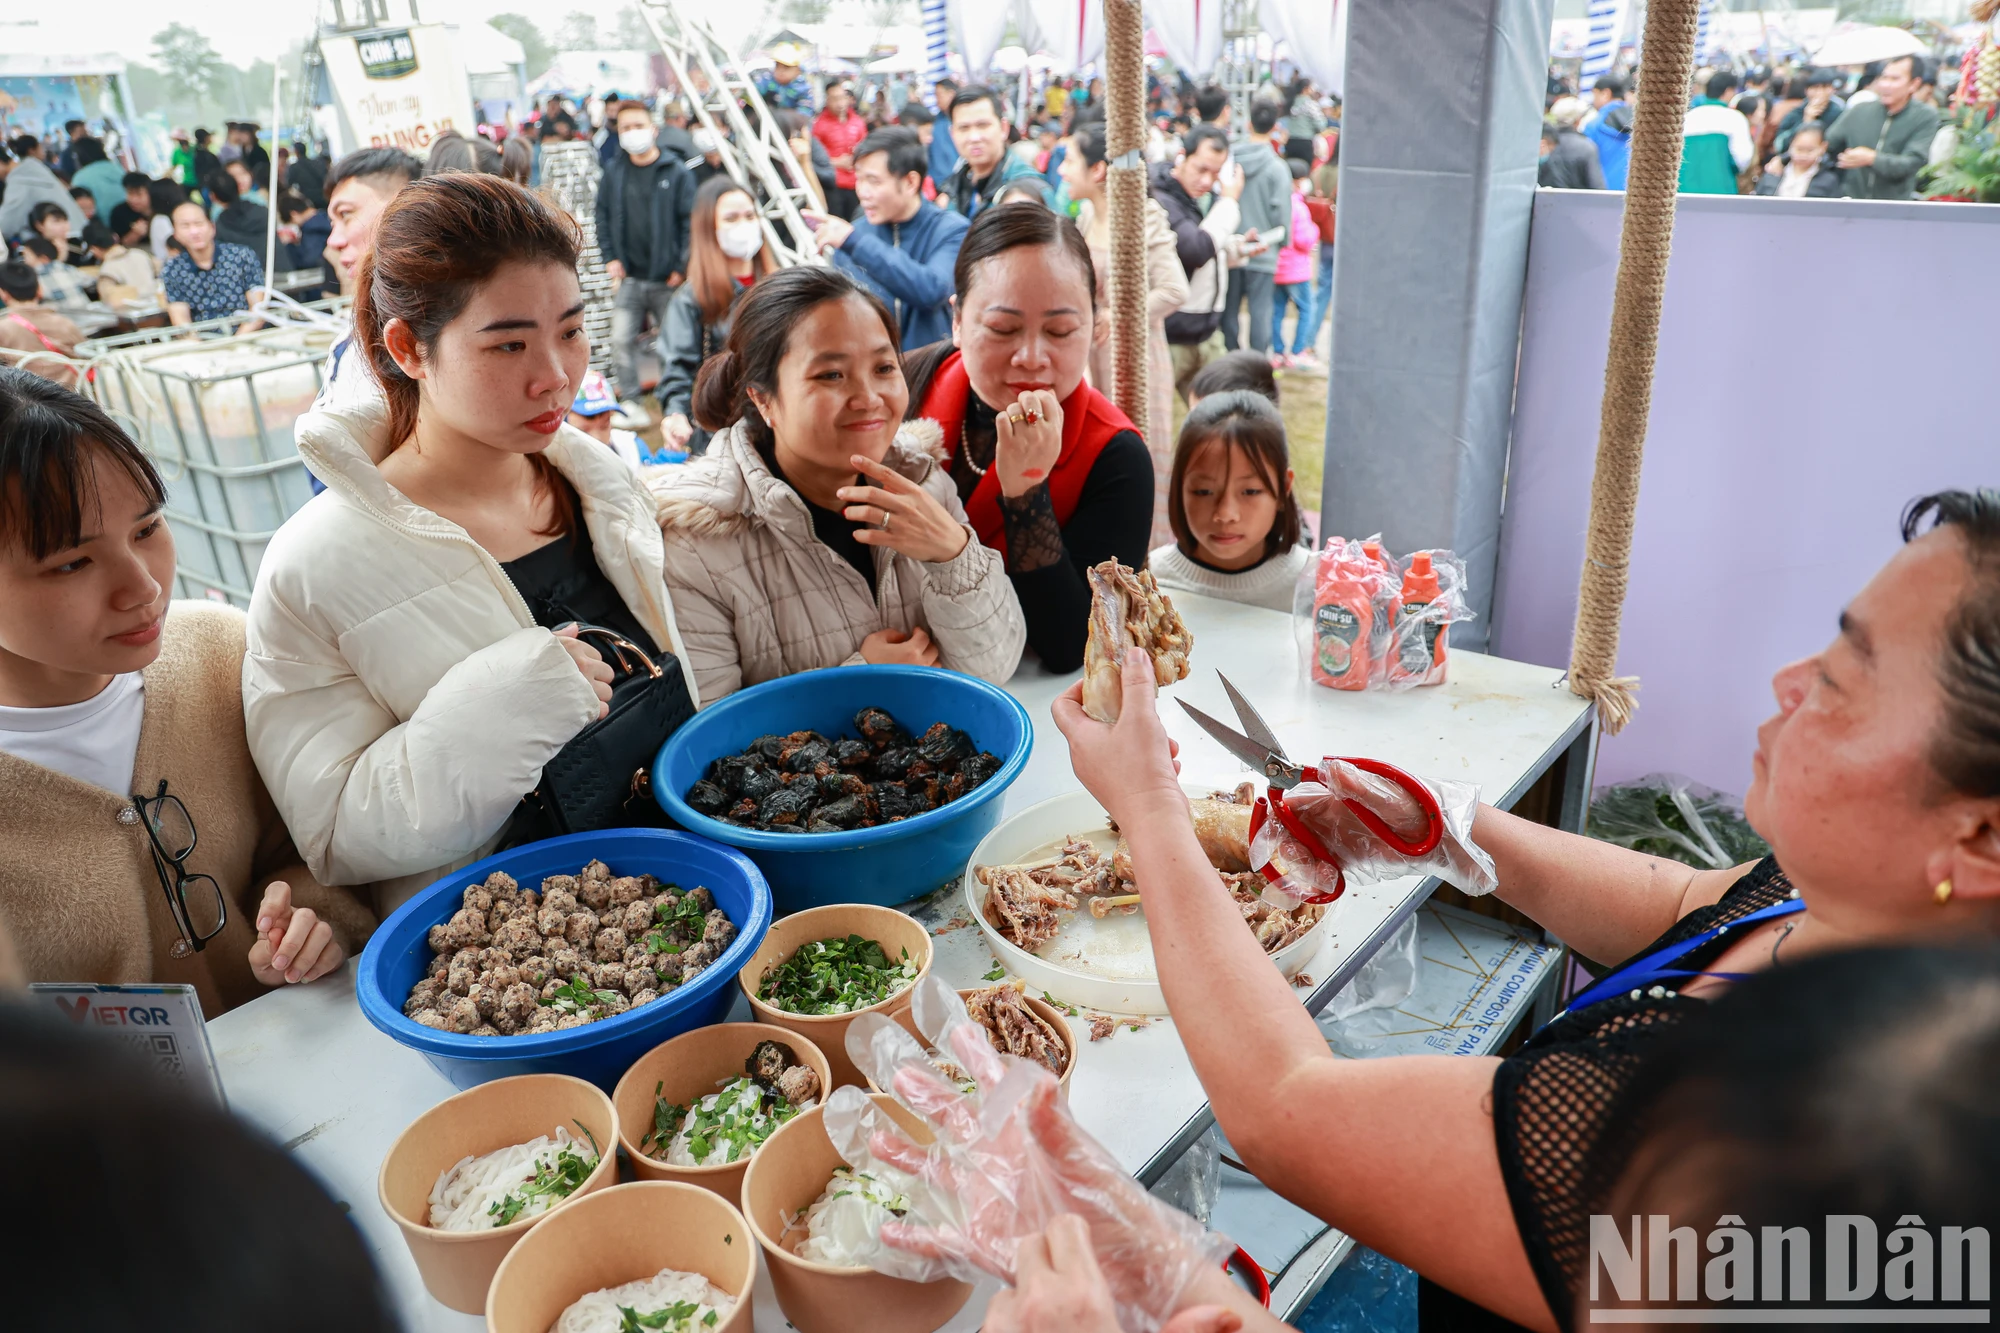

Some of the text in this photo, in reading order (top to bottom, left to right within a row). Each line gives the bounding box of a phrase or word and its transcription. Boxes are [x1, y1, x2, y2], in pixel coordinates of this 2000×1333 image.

[1319, 609, 1353, 624] CHIN-SU
[55, 995, 171, 1026] VIETQR
[1472, 974, 1525, 1034] COMPOSITE
